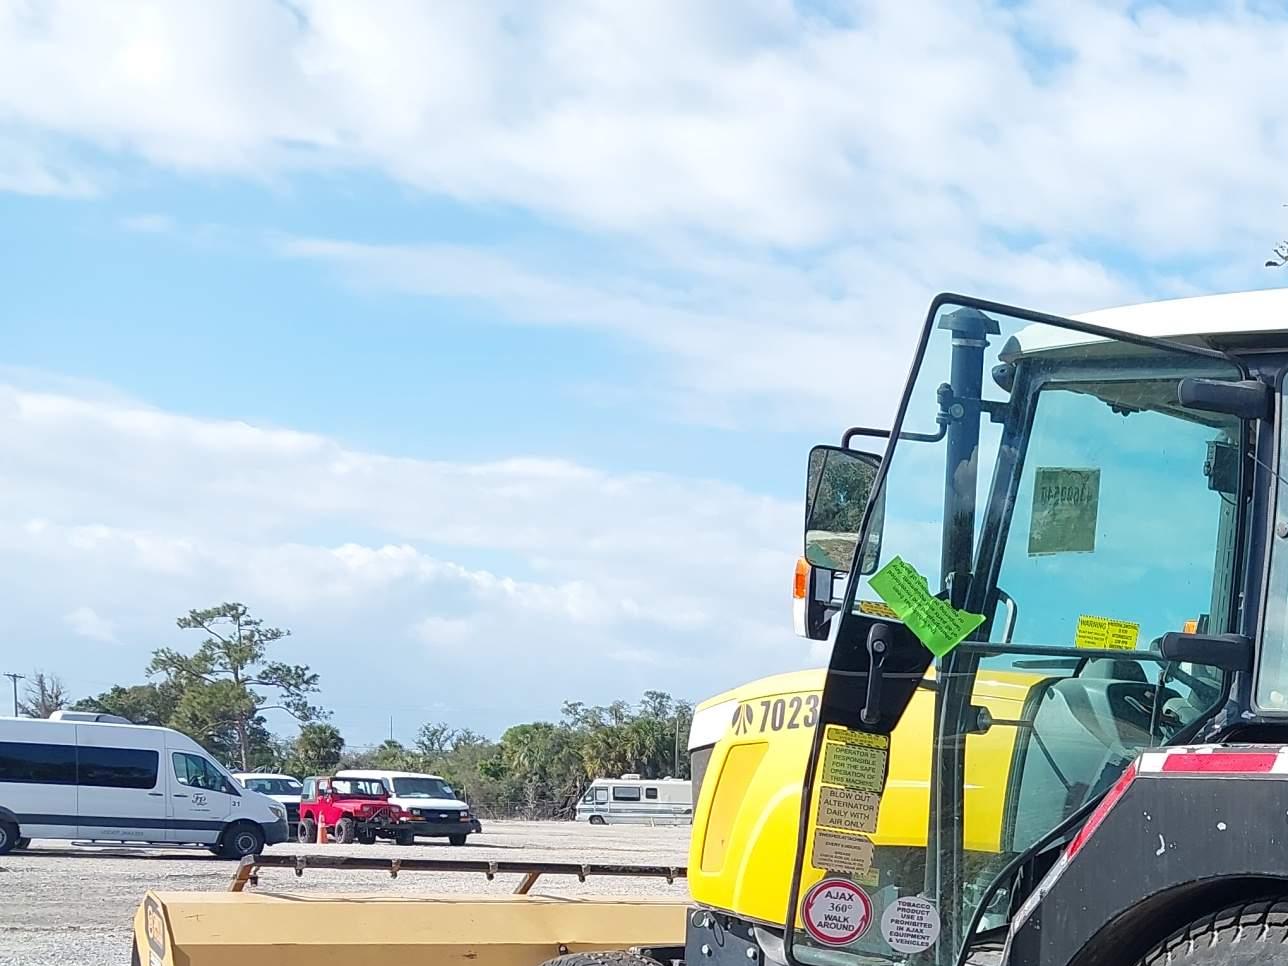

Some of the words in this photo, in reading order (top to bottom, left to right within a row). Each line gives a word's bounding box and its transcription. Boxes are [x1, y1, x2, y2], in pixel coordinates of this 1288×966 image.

[1081, 620, 1107, 630] WARNING
[760, 694, 820, 733] 7023
[836, 747, 868, 757] OPERATOR
[833, 755, 876, 766] RESPONSIBLE
[831, 761, 845, 769] FOR
[847, 763, 860, 771] THE
[860, 765, 876, 774] SAFE
[830, 768, 866, 779] OPERATION
[829, 790, 853, 800] BLOW
[854, 793, 871, 802] OUT
[824, 799, 874, 811] ALTERNATOR
[826, 808, 848, 817] DAILY
[850, 811, 870, 820] WITH
[844, 820, 865, 828] ONLY
[824, 890, 855, 902] AJAX
[828, 902, 853, 913] 360°
[897, 900, 931, 909] TOBACCO
[896, 907, 930, 916] PRODUCT
[824, 913, 849, 923] WALK
[890, 918, 933, 929] PROHIBITED
[816, 921, 855, 932] AROUND
[889, 931, 930, 941] EQUIPMENT
[895, 938, 930, 947] VEHICLES
